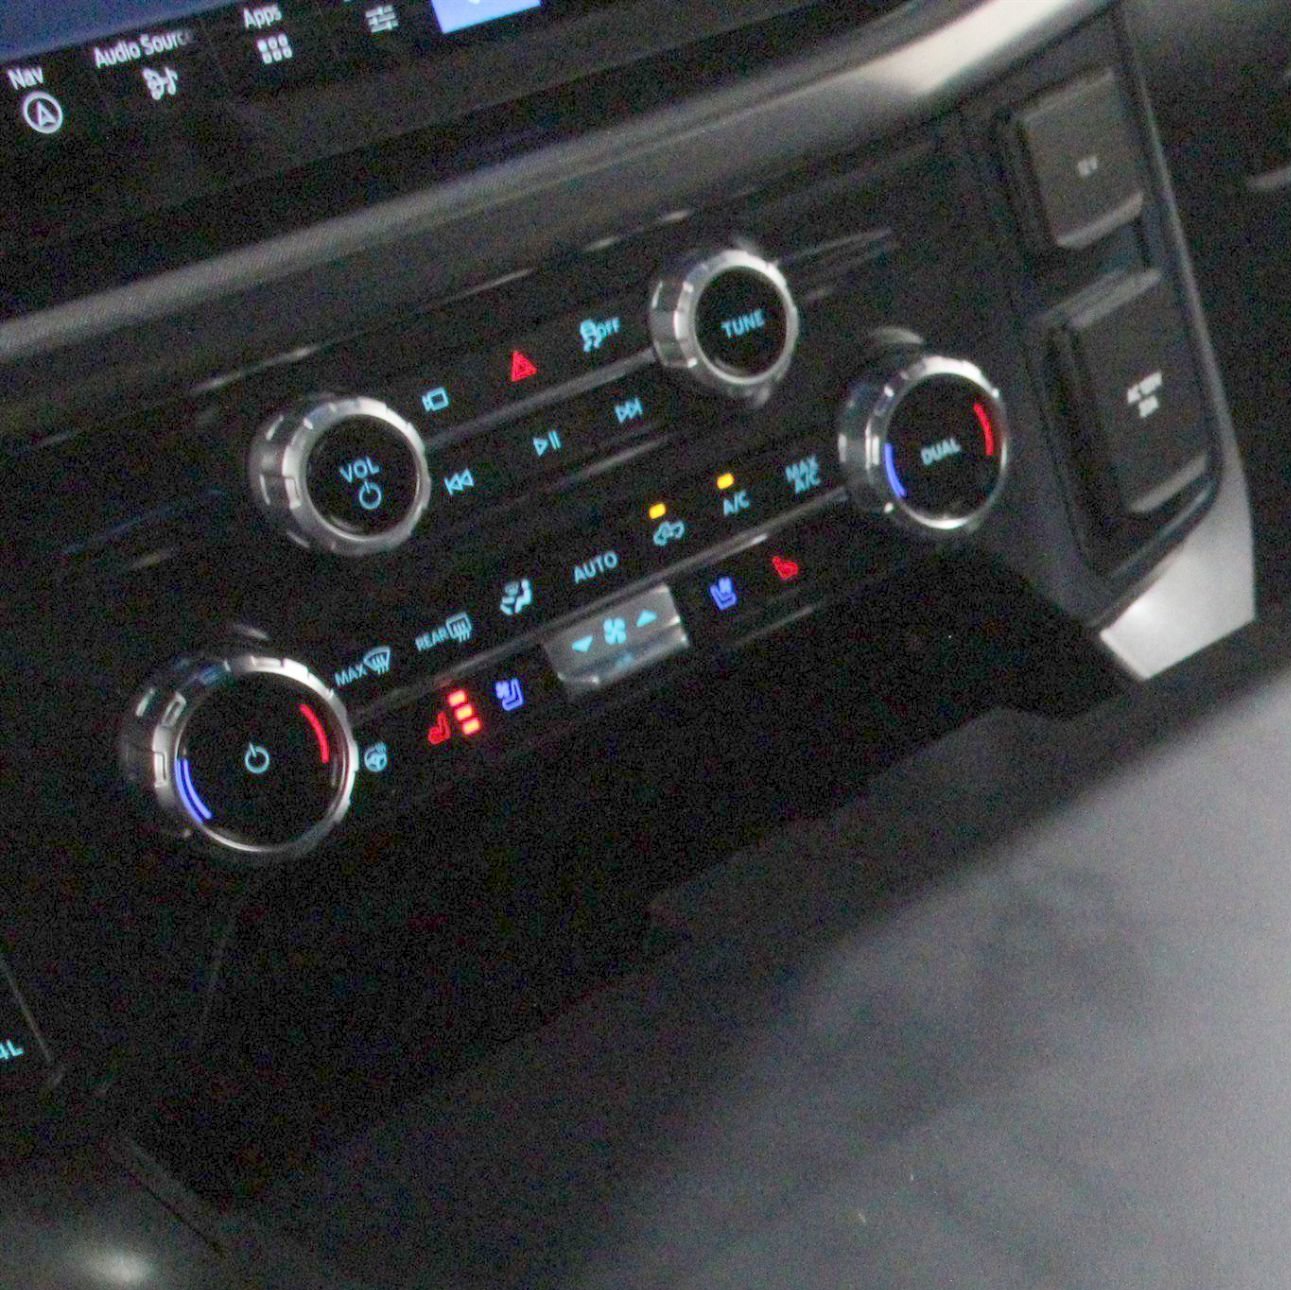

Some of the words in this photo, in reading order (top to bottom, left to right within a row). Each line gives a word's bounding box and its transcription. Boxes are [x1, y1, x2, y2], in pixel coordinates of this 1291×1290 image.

[243, 4, 282, 29] Apps
[94, 41, 141, 68] Audio
[7, 66, 44, 90] Nav
[598, 317, 620, 339] OFF
[721, 308, 765, 338] TUNE
[921, 437, 960, 465] DUAL
[340, 455, 380, 483] VOL
[723, 490, 749, 516] A/C
[574, 551, 618, 584] AUTO
[415, 626, 449, 651] REAR
[335, 663, 367, 686] MAX
